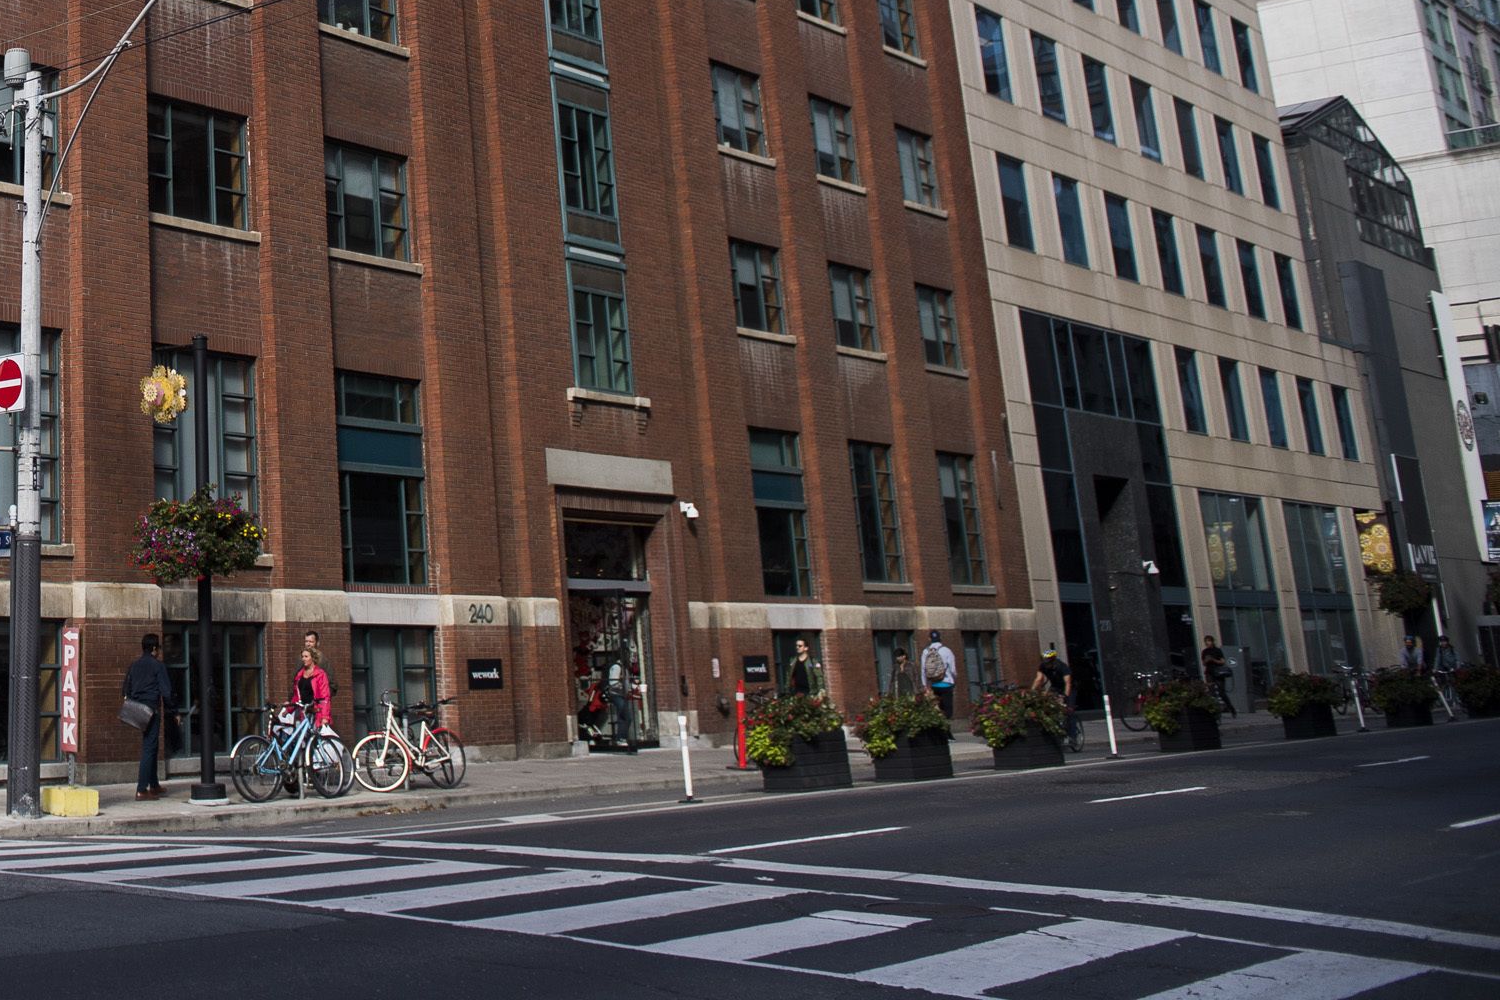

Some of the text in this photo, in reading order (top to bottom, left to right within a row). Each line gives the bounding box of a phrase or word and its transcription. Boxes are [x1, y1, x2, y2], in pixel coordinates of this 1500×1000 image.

[468, 604, 493, 623] 240
[472, 668, 500, 679] wework
[746, 663, 767, 673] wework
[63, 645, 76, 745] PARK
